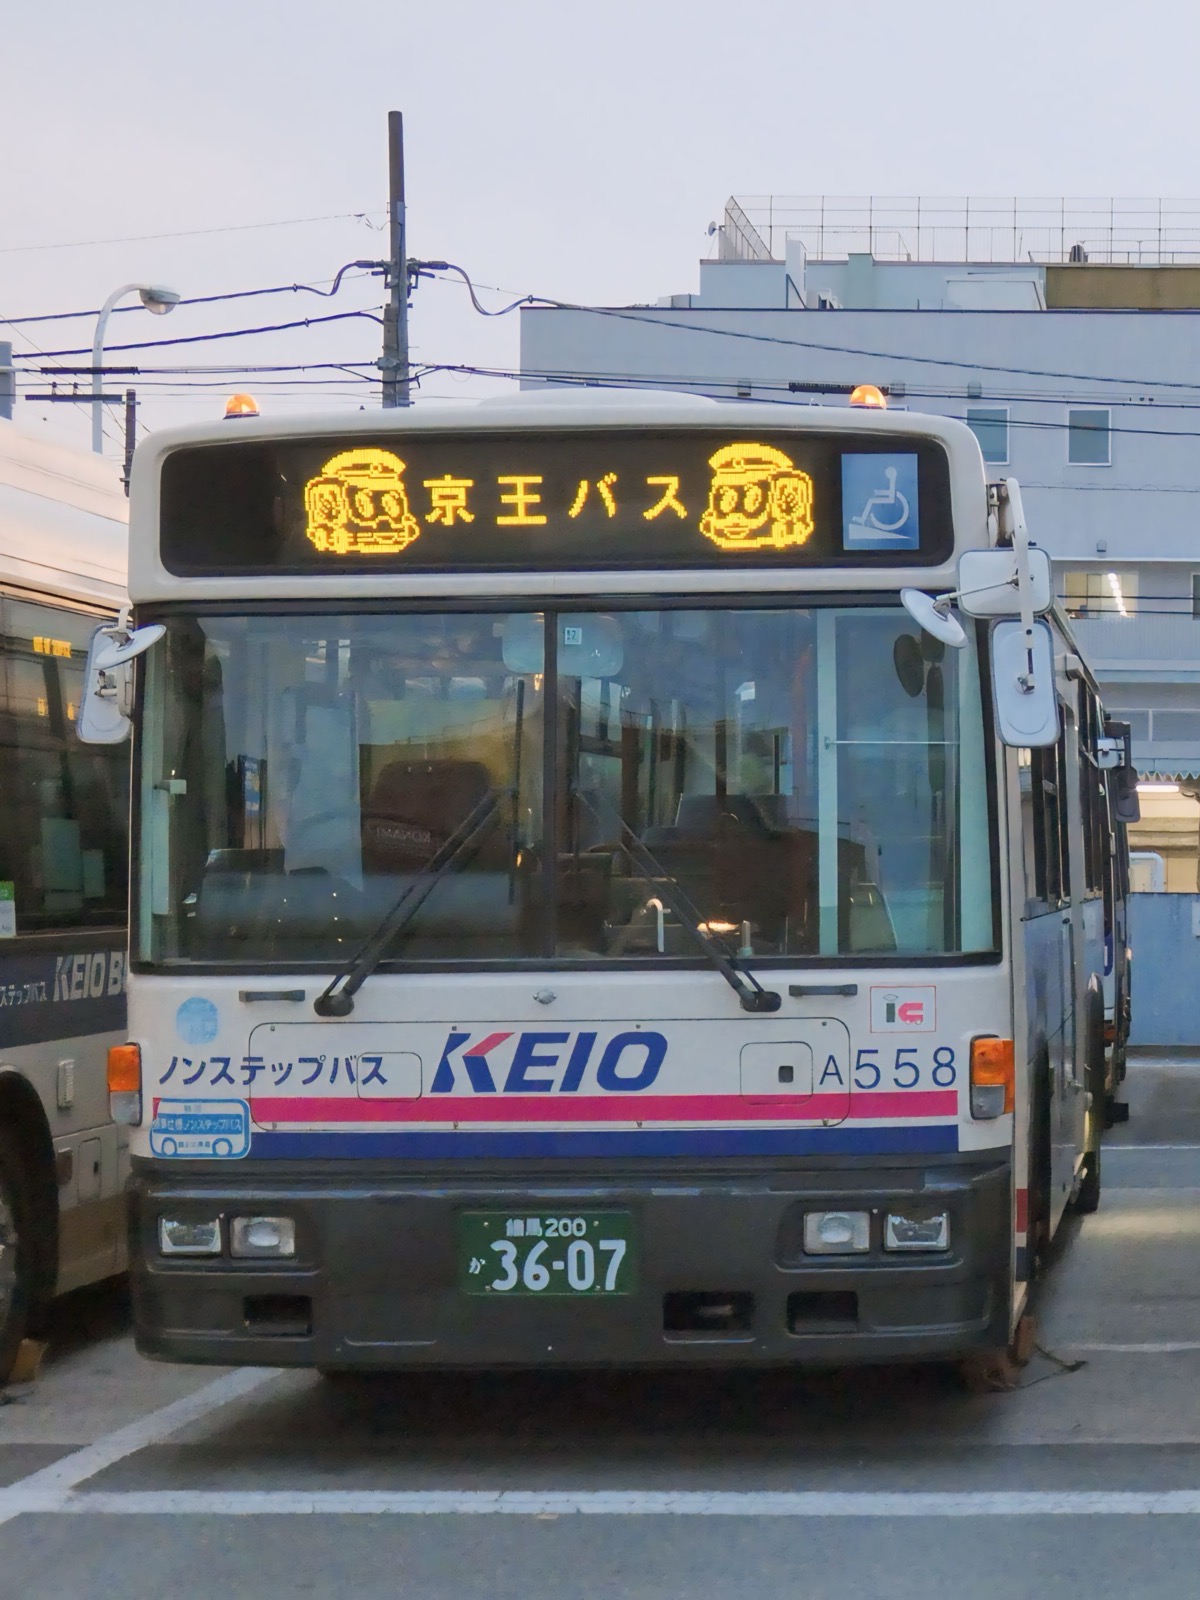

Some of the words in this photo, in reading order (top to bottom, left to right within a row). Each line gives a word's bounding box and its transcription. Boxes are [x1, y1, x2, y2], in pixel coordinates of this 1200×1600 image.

[423, 473, 688, 526] 京王バス
[53, 952, 106, 1002] KEIO
[107, 951, 128, 996] B
[159, 1055, 388, 1086] ノンステップバス
[430, 1031, 668, 1093] KEIO
[819, 1046, 956, 1089] A558
[544, 1217, 587, 1237] 200
[490, 1239, 626, 1291] 36-07
